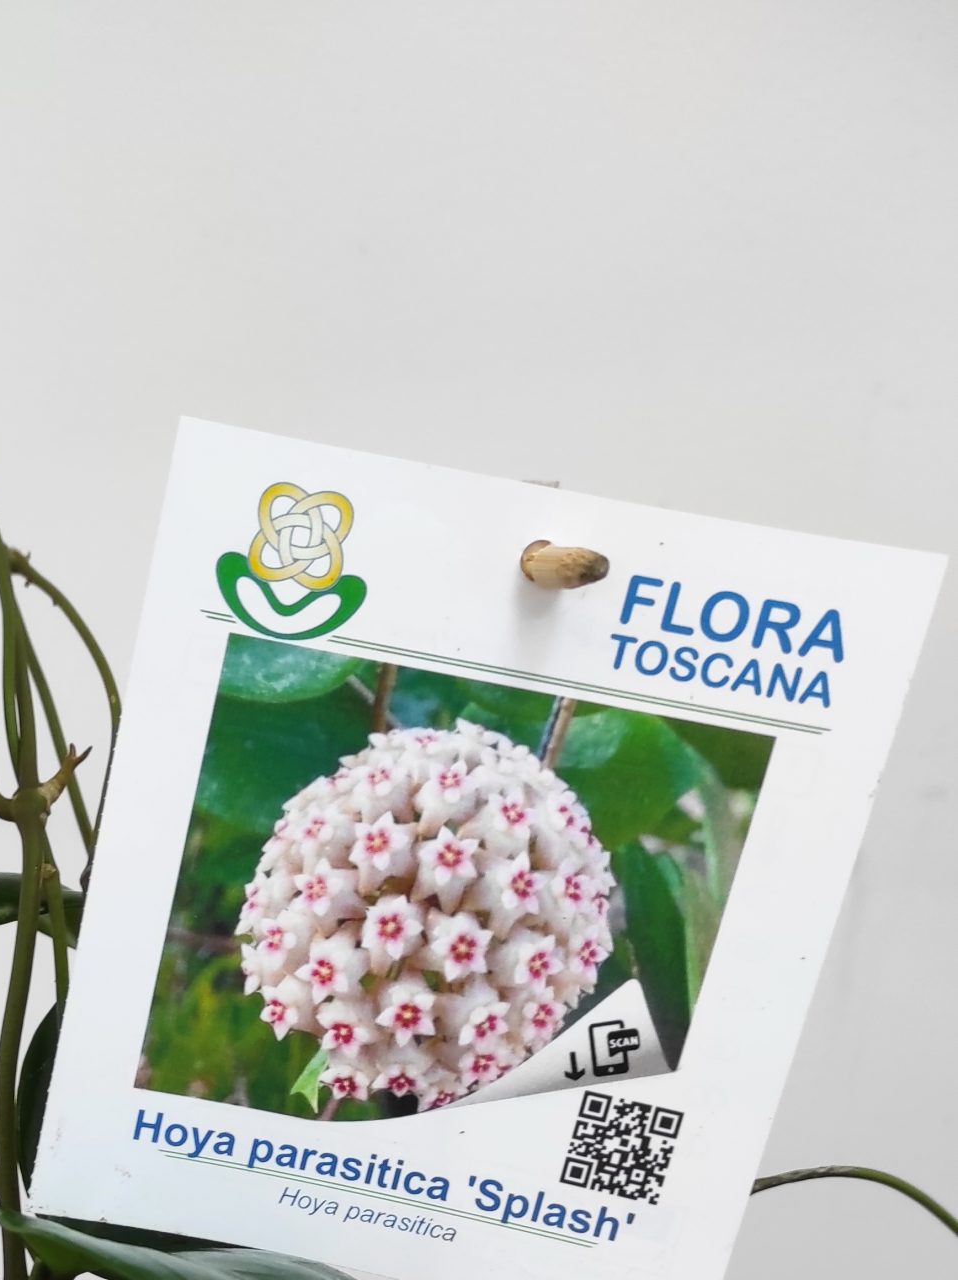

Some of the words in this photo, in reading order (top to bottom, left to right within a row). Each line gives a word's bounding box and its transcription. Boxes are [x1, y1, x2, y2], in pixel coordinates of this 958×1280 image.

[620, 575, 843, 663] FLORA
[610, 634, 831, 709] TOSCANA
[609, 1035, 639, 1048] SCAN
[133, 1109, 234, 1159] Hoya
[247, 1136, 451, 1201] parasitica
[468, 1175, 636, 1242] 'Splash'
[278, 1186, 340, 1219] Hoya
[343, 1201, 458, 1243] parasitica
